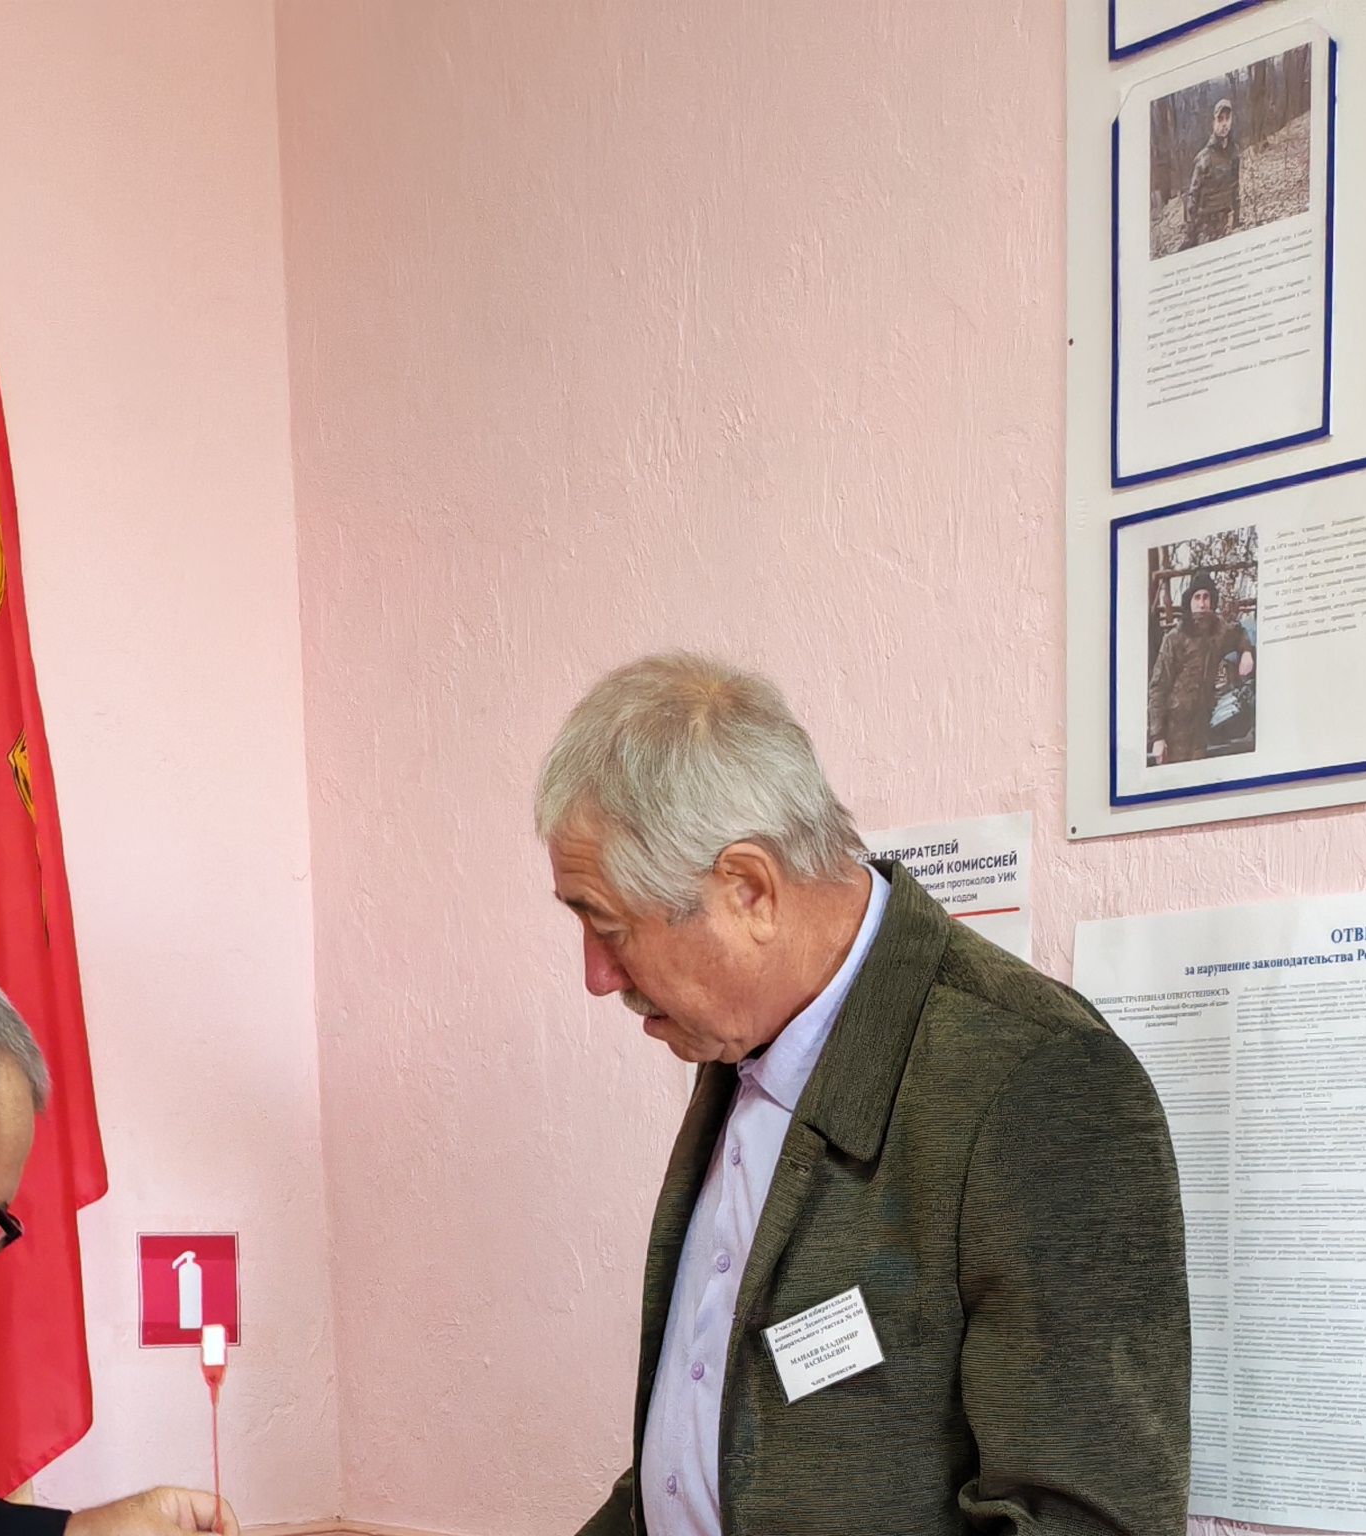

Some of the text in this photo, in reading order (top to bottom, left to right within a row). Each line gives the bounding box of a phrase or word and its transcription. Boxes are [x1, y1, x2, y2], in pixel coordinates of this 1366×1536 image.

[880, 839, 959, 861] ИЗБИРАТЕЛЕЙ
[946, 850, 1018, 874] КОМИССИЕЙ
[946, 875, 996, 891] протоколов
[997, 870, 1017, 883] УИК
[952, 893, 978, 904] кодом
[1183, 964, 1195, 976] за
[1196, 959, 1251, 977] нарушение
[1251, 952, 1354, 970] законодательства
[1166, 987, 1230, 1001] ОТВЕТСТВЕННОСТЬ
[819, 1330, 860, 1354] ВЛАДИМИР
[803, 1343, 851, 1370] ВАСИЛЬЕВИЧ
